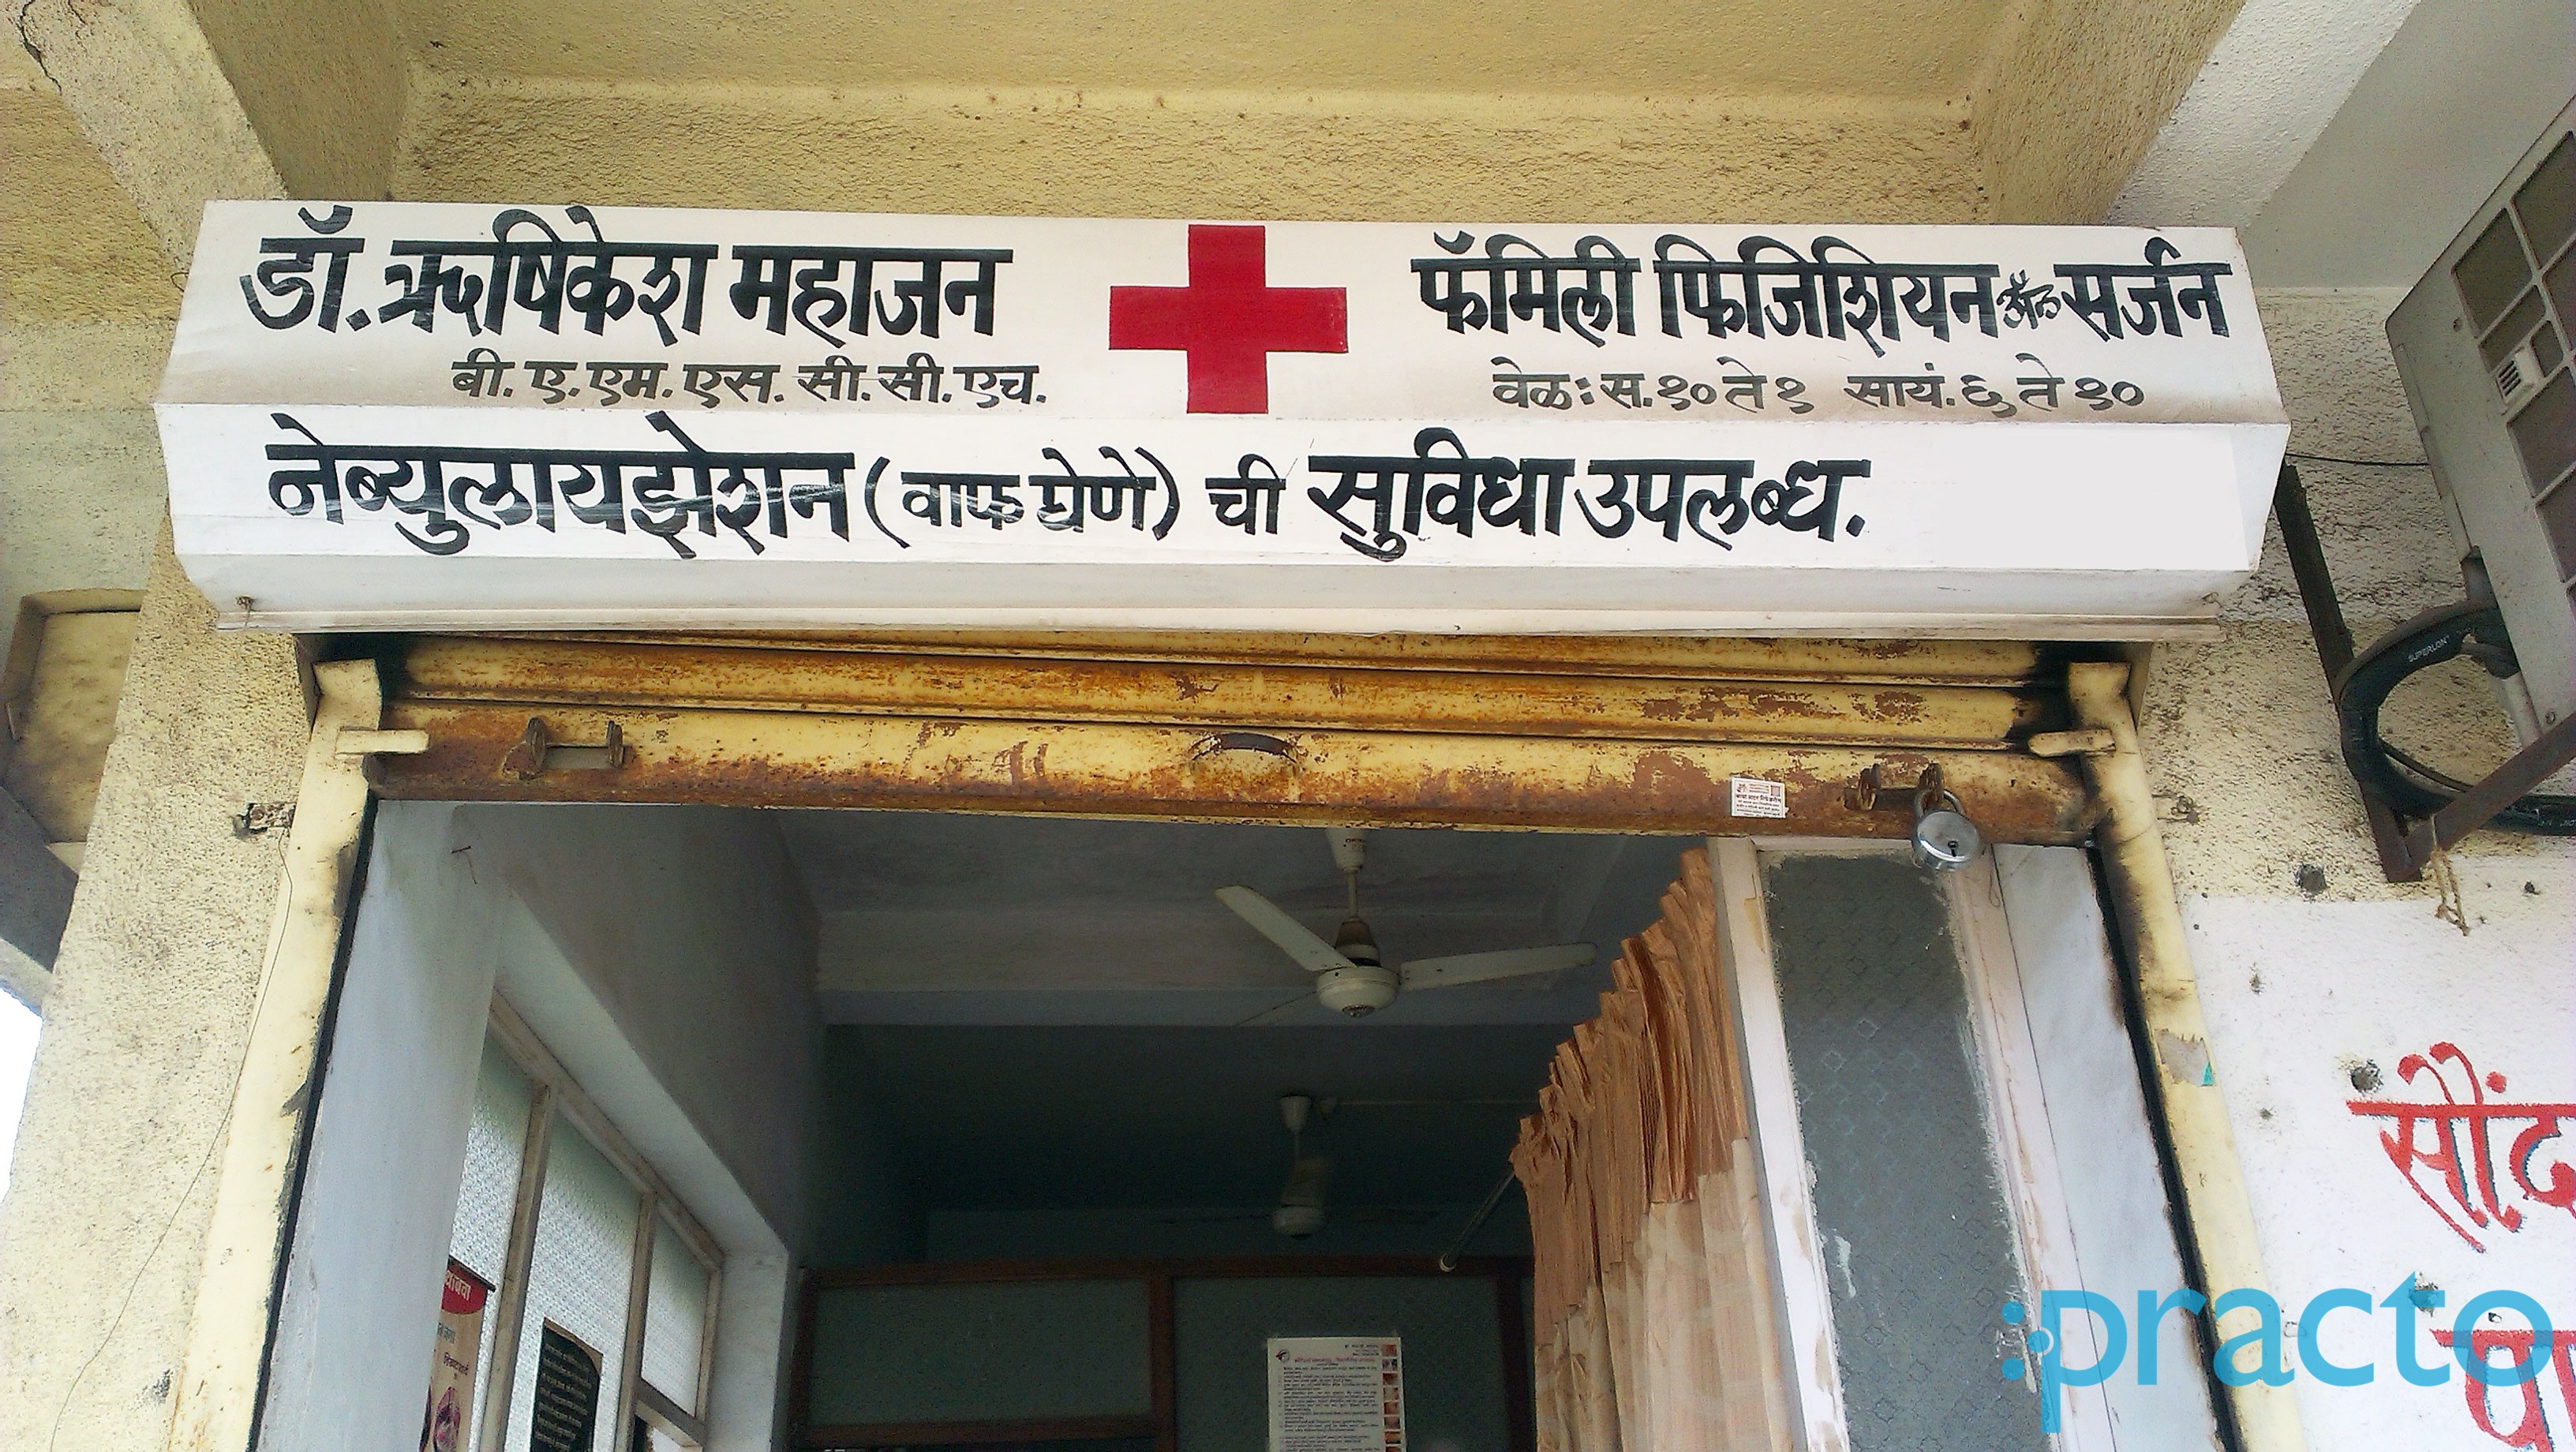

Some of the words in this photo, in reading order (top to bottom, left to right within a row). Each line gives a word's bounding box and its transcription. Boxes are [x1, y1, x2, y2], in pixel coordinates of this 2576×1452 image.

[729, 245, 1013, 348] महाजन
[1410, 230, 1642, 347] फॅमिली
[1653, 234, 1998, 357] फिजिशियन
[2053, 237, 2233, 342] सर्जन
[1205, 454, 1286, 535] ची
